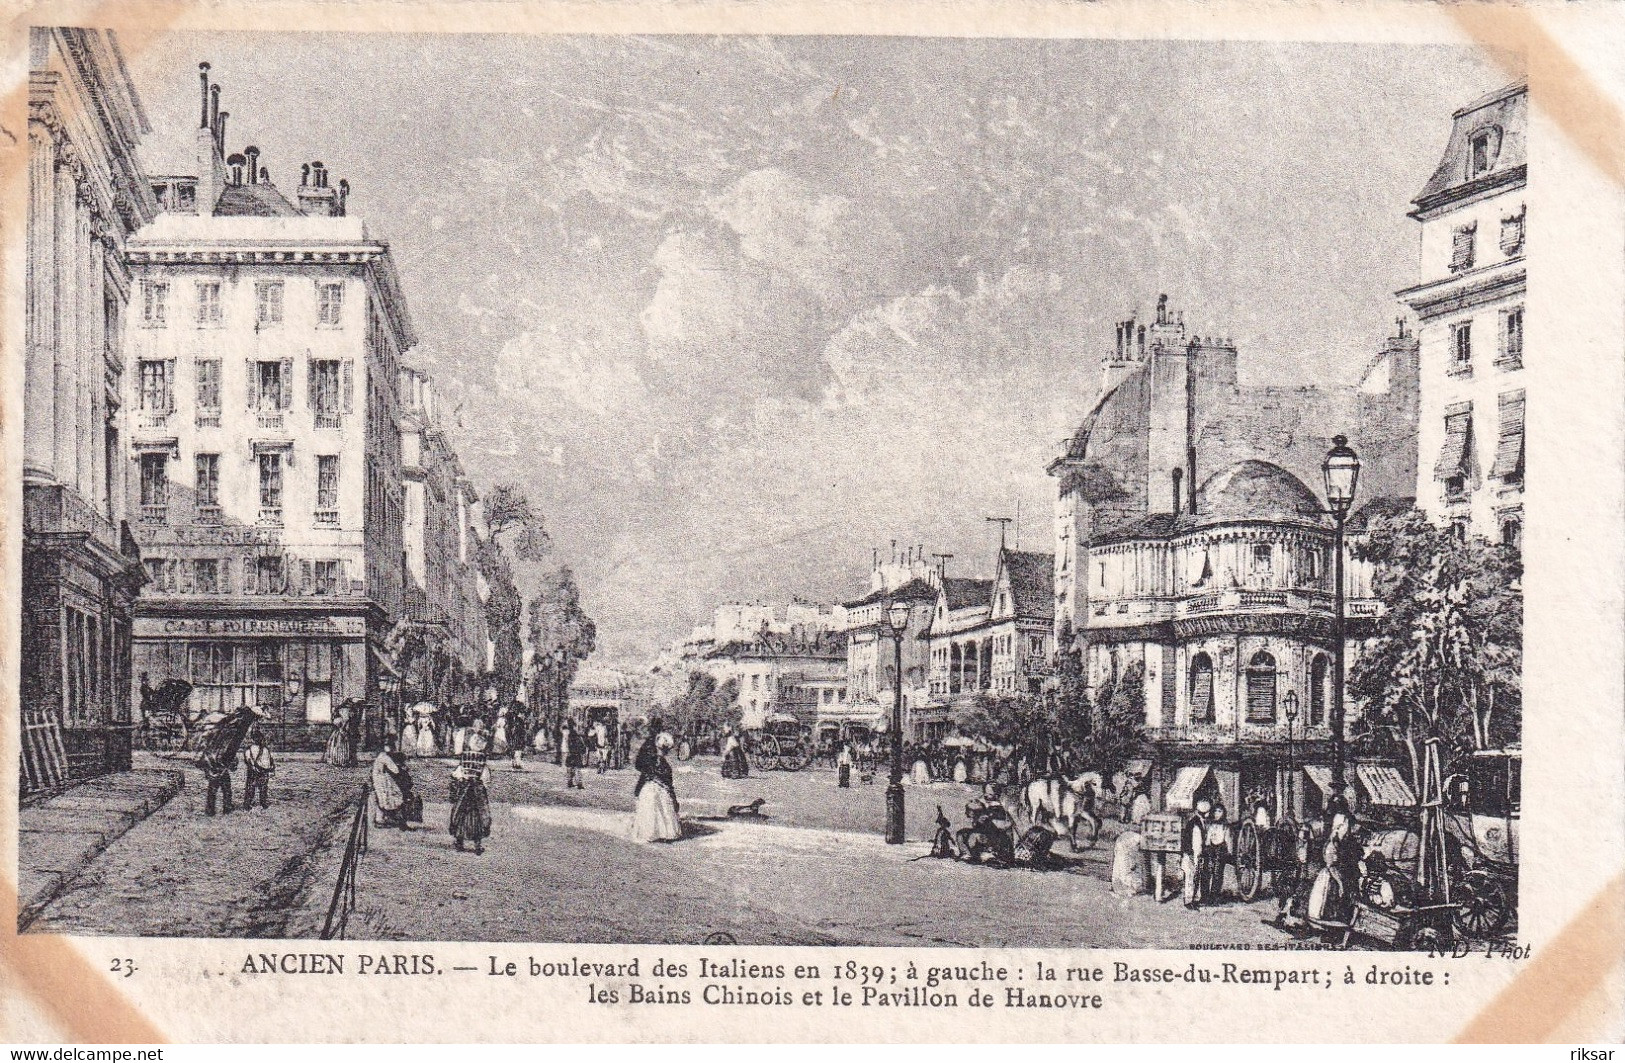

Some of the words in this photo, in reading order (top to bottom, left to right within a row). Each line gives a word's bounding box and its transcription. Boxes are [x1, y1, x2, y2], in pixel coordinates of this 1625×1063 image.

[1189, 943, 1251, 951] BOULEVARD
[241, 953, 344, 975] ANCIEN
[359, 954, 442, 976] PARIS.
[489, 955, 516, 977] Le
[529, 956, 639, 978] boulevard
[653, 957, 688, 978] des
[700, 957, 785, 979] Italiens
[795, 966, 821, 980] en
[834, 960, 897, 986] 1839;
[907, 960, 919, 981] à
[927, 960, 1008, 988] gauche
[1037, 961, 1056, 981] la
[1067, 967, 1103, 982] rue
[1114, 961, 1332, 991] Basse-du-Rempart;
[1344, 965, 1356, 985] à
[1366, 964, 1434, 986] droite
[589, 984, 619, 1004] les
[629, 984, 691, 1005] Bains
[703, 985, 793, 1006] Chinois
[802, 989, 823, 1007] et
[833, 986, 853, 1007] le
[862, 986, 958, 1008] Pavillon
[968, 988, 994, 1008] de
[1005, 987, 1103, 1009] Hanovre
